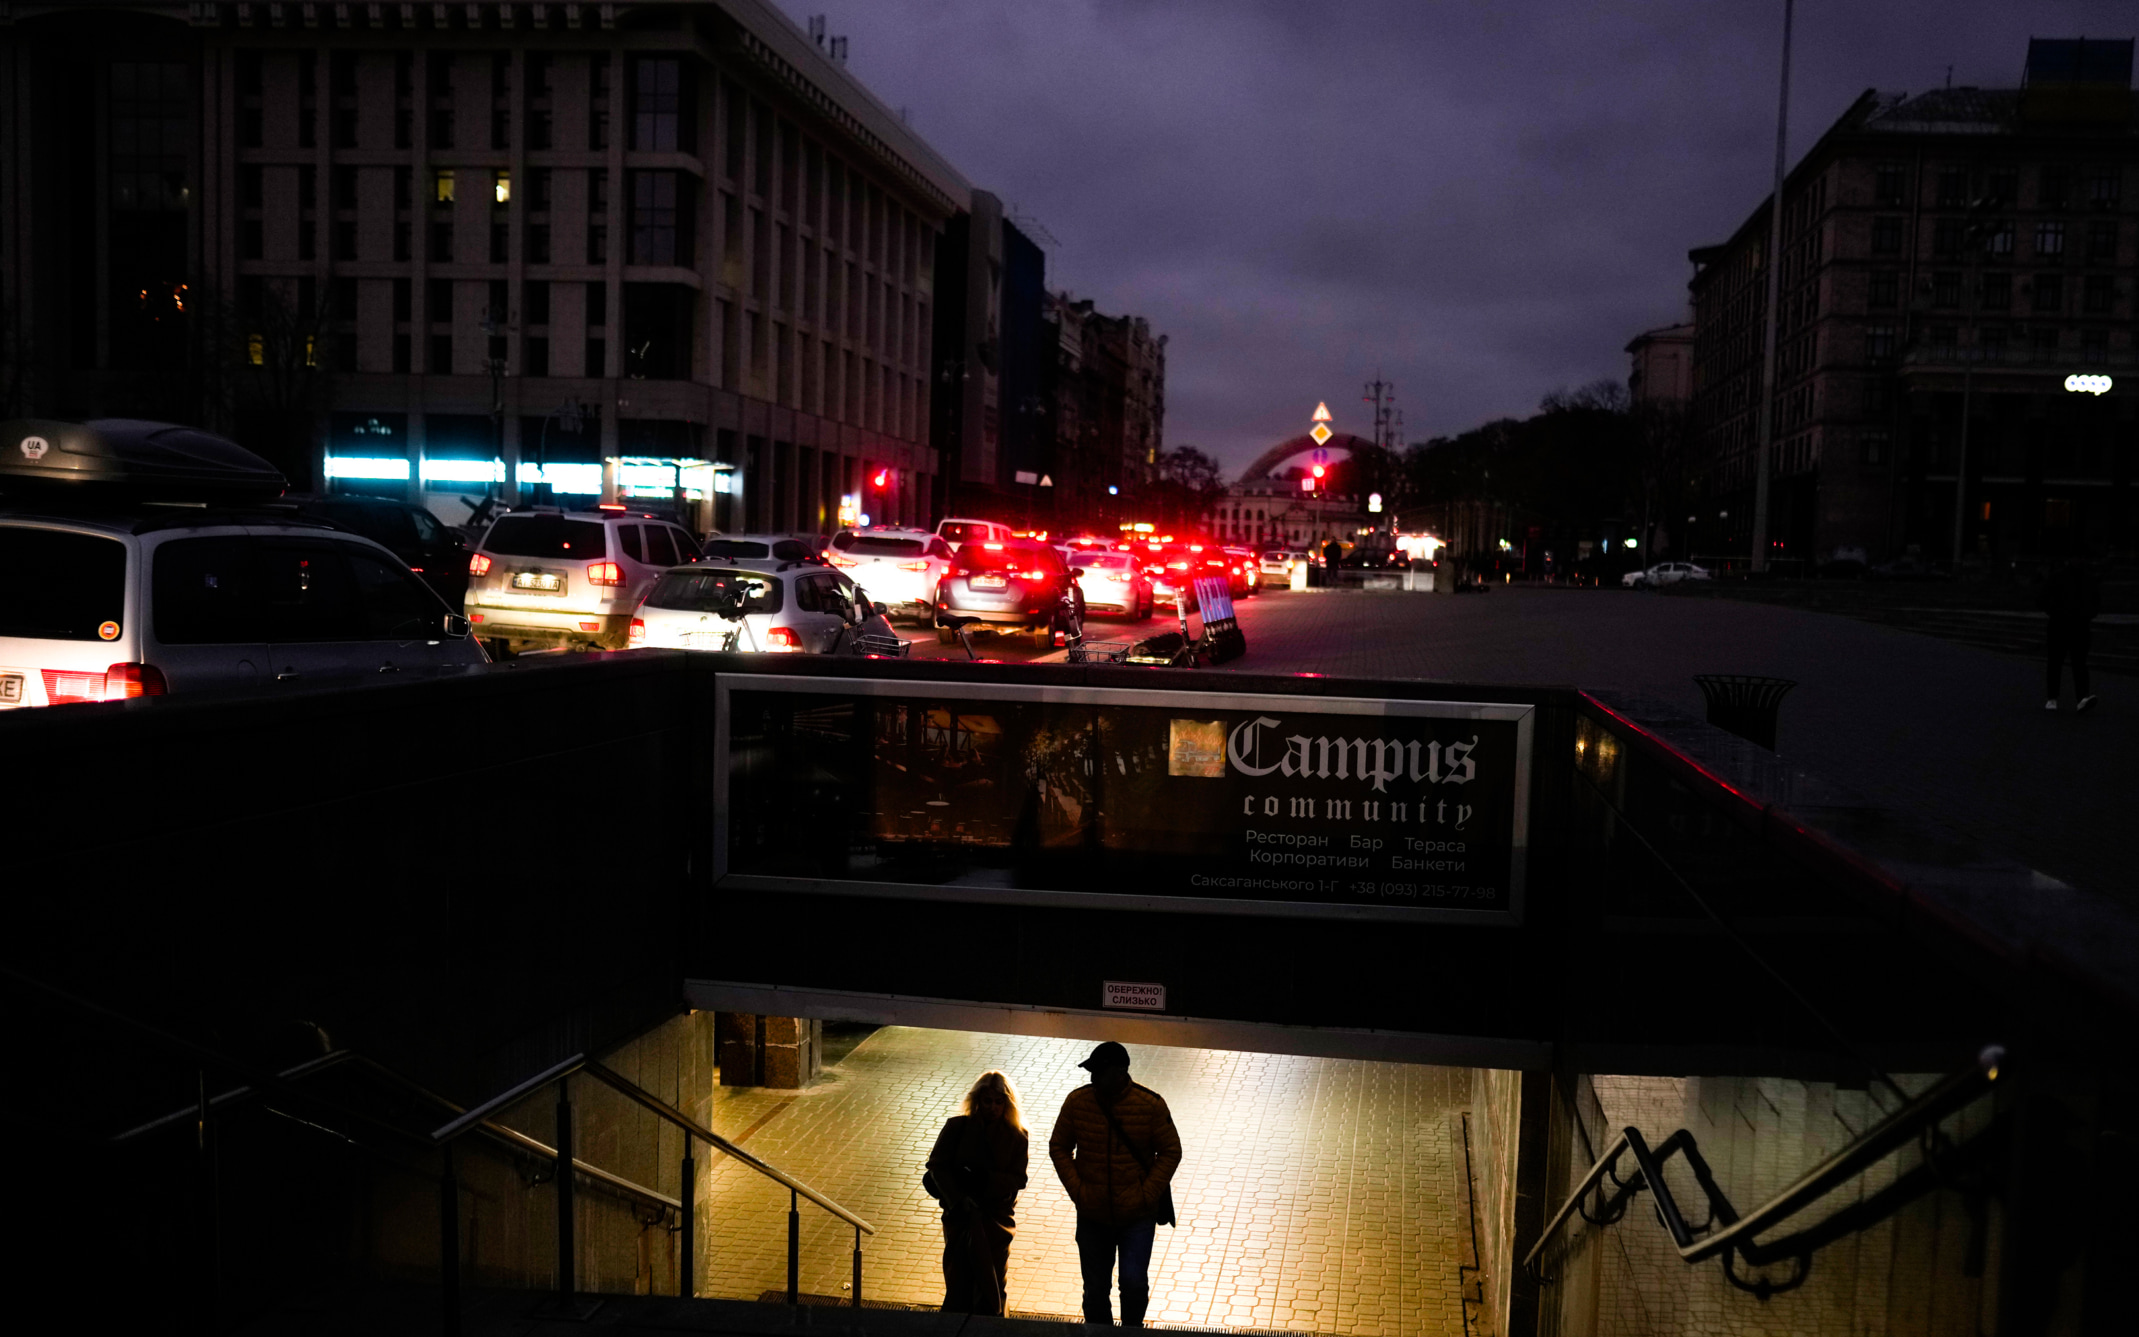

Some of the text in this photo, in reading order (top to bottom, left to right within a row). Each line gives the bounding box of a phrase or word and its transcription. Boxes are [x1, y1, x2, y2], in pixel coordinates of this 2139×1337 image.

[27, 440, 41, 450] UA
[1228, 716, 1478, 793] Campus
[1243, 795, 1472, 830] community
[1246, 830, 1466, 854] Ресторан Бар Тераса
[1250, 849, 1465, 872] Корпоративи Банкети
[1190, 874, 1496, 900] Саксаганського 1-Г +38 (093) 215-77-98
[1107, 985, 1162, 995] ОБЕРЕЖНО!
[1112, 996, 1157, 1006] СЛИЗЬКО
